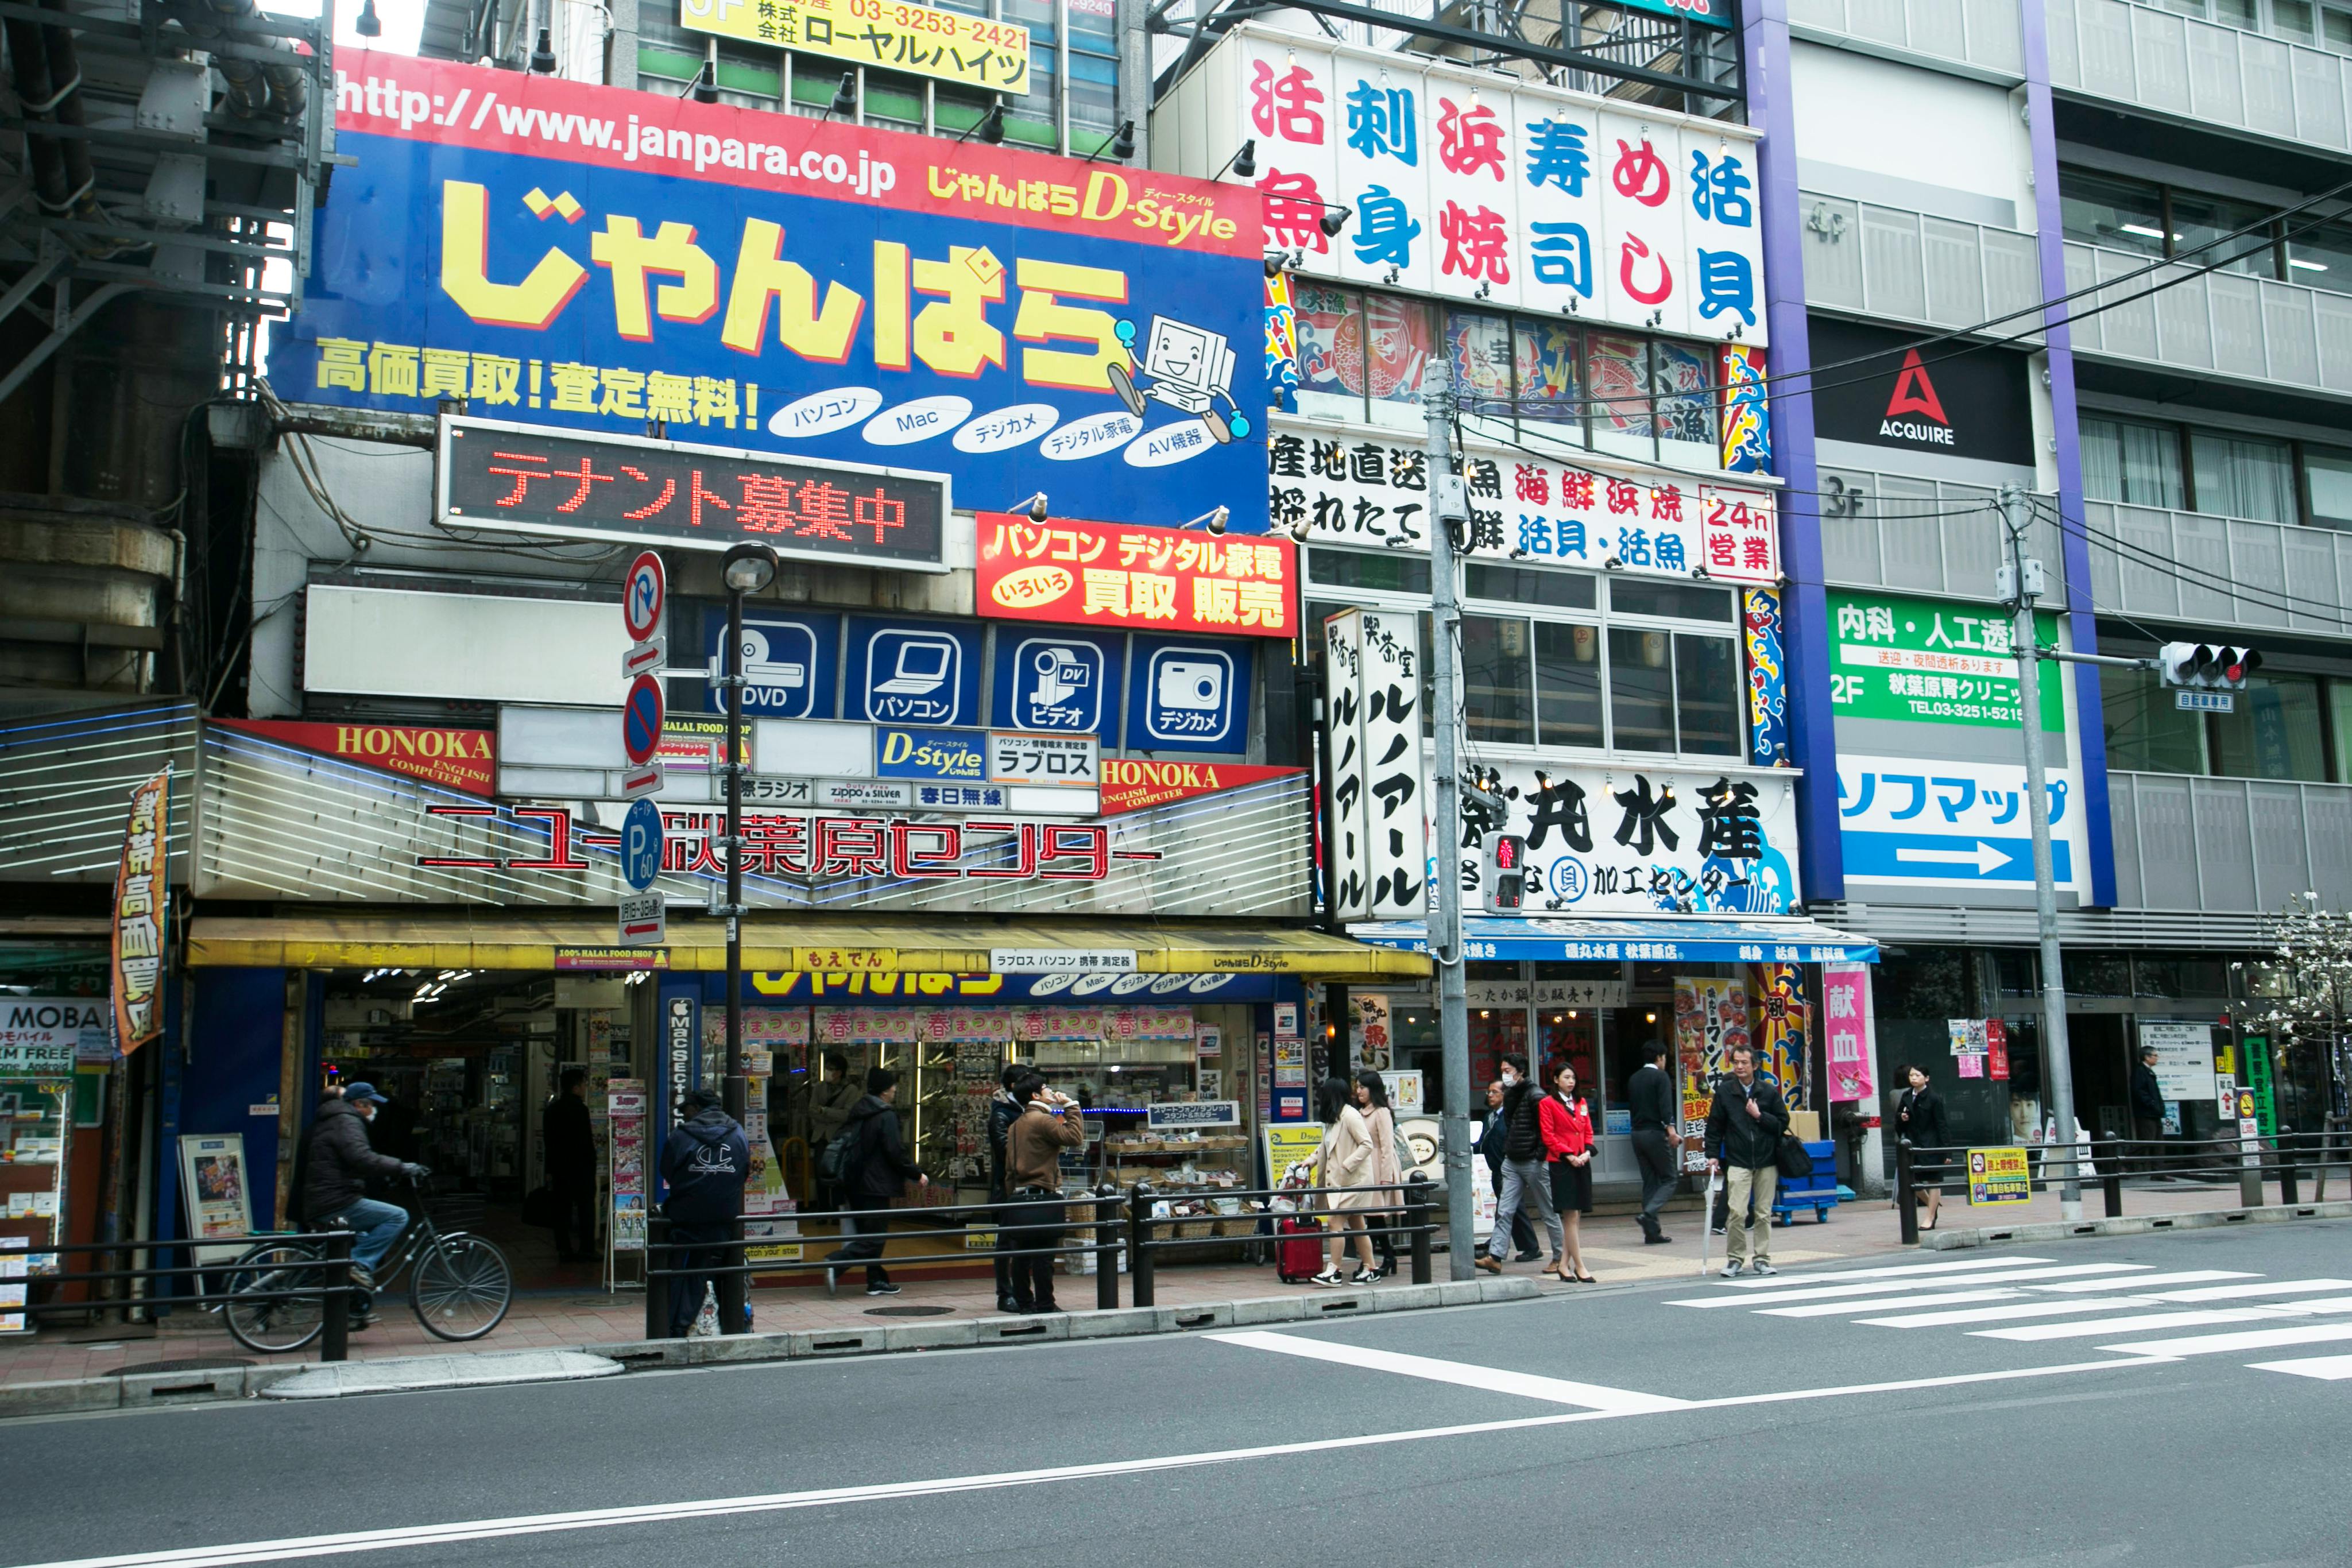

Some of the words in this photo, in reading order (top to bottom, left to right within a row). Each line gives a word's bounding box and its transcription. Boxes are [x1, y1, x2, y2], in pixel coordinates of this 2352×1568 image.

[758, 22, 798, 44] 会社
[805, 15, 1027, 85] ローヤルハイツ
[335, 69, 896, 199] http://www.janpara.co.jp
[1251, 58, 1329, 255] 活魚
[1347, 79, 1422, 270] 刺身
[1437, 96, 1511, 285] 浜焼
[928, 165, 1078, 217] じゃんぱら
[1081, 171, 1237, 245] D-Style
[1526, 117, 1593, 300] 寿司
[1612, 139, 1674, 305] めし
[1808, 202, 1846, 243] 4F
[1690, 149, 1756, 327] 活貝
[442, 180, 1134, 393] じゃんぱら
[794, 397, 857, 428] パソコン
[896, 408, 939, 432] Mac
[975, 413, 1038, 442] デジカメ
[1051, 417, 1134, 454] デジタル家電
[1879, 419, 1955, 446] ACQUIRE
[1147, 426, 1203, 458] AV機器
[1269, 434, 1502, 500] 産地直送魚
[489, 452, 906, 544] テナント募集中
[1515, 463, 1684, 522] 海鮮浜焼
[1824, 476, 1863, 519] 3F
[993, 524, 1107, 563] パソコン
[1119, 535, 1283, 579] デジタル家電
[1519, 514, 1685, 571] 活貝・活魚
[1709, 533, 1769, 571] 営業
[999, 572, 1067, 601] いろいろ
[1082, 568, 1178, 620] 買取
[1193, 577, 1285, 628] 販売
[1838, 603, 2036, 654] 内科・人工透
[1363, 614, 1415, 679] 喫茶室
[1061, 668, 1084, 681] DV
[1878, 651, 2003, 674] 送迎・夜間透析あります
[741, 687, 787, 707] DVD
[1831, 675, 1864, 704] 2F
[1889, 673, 2040, 703] 秋葉原腎クリニッ
[2181, 694, 2229, 708] 自転車専用
[875, 697, 949, 718] パソコン
[1032, 706, 1084, 726] ビデオ
[697, 722, 724, 733] FOOD
[1160, 712, 1217, 731] デジカメ
[336, 727, 492, 760] HONOKA
[882, 732, 982, 775] D-Style
[999, 738, 1028, 748] パソコン
[389, 758, 463, 785] COMPUTER
[433, 760, 490, 783] ENGLISH
[949, 766, 981, 777] じゃんぱら
[998, 750, 1091, 776] ラブロス
[1101, 761, 1220, 788] HONOKA
[872, 790, 901, 799] SILVER
[920, 787, 1002, 806] 春日無線
[1102, 787, 1147, 804] ENGLISH
[1125, 788, 1183, 807] COMPUTER
[1332, 687, 1366, 912] ルノアール
[1367, 683, 1423, 907] ルノアール
[630, 824, 645, 881] P
[640, 853, 652, 878] 60
[1461, 860, 1543, 894] さな
[1594, 863, 1750, 897] 加工センター
[582, 950, 608, 958] HALAL
[609, 950, 631, 958] FOOD
[632, 950, 653, 958] SHOP
[808, 951, 883, 969] もえでん
[997, 956, 1035, 966] ラブロス
[1039, 955, 1076, 966] パソコン
[1080, 955, 1098, 967] 携帯
[1101, 955, 1131, 968] 測定器
[1625, 943, 1677, 960] 秋葉原店
[1040, 973, 1070, 991] パソコン
[1085, 975, 1105, 989] Mac
[1469, 988, 1529, 1004] ったか鍋
[1768, 996, 1785, 1018] 祝
[9, 1006, 102, 1029] MOBA
[829, 1012, 907, 1038] 春まつり
[928, 1012, 1004, 1038] 春まつり
[1024, 1011, 1098, 1037] 春まつり
[1116, 1010, 1186, 1036] 春まつり
[1828, 984, 1860, 1063] 献血
[25, 1048, 71, 1060] FREE
[29, 1062, 69, 1072] Android
[745, 1248, 762, 1258] atch
[764, 1248, 779, 1257] your
[782, 1246, 799, 1257] step
